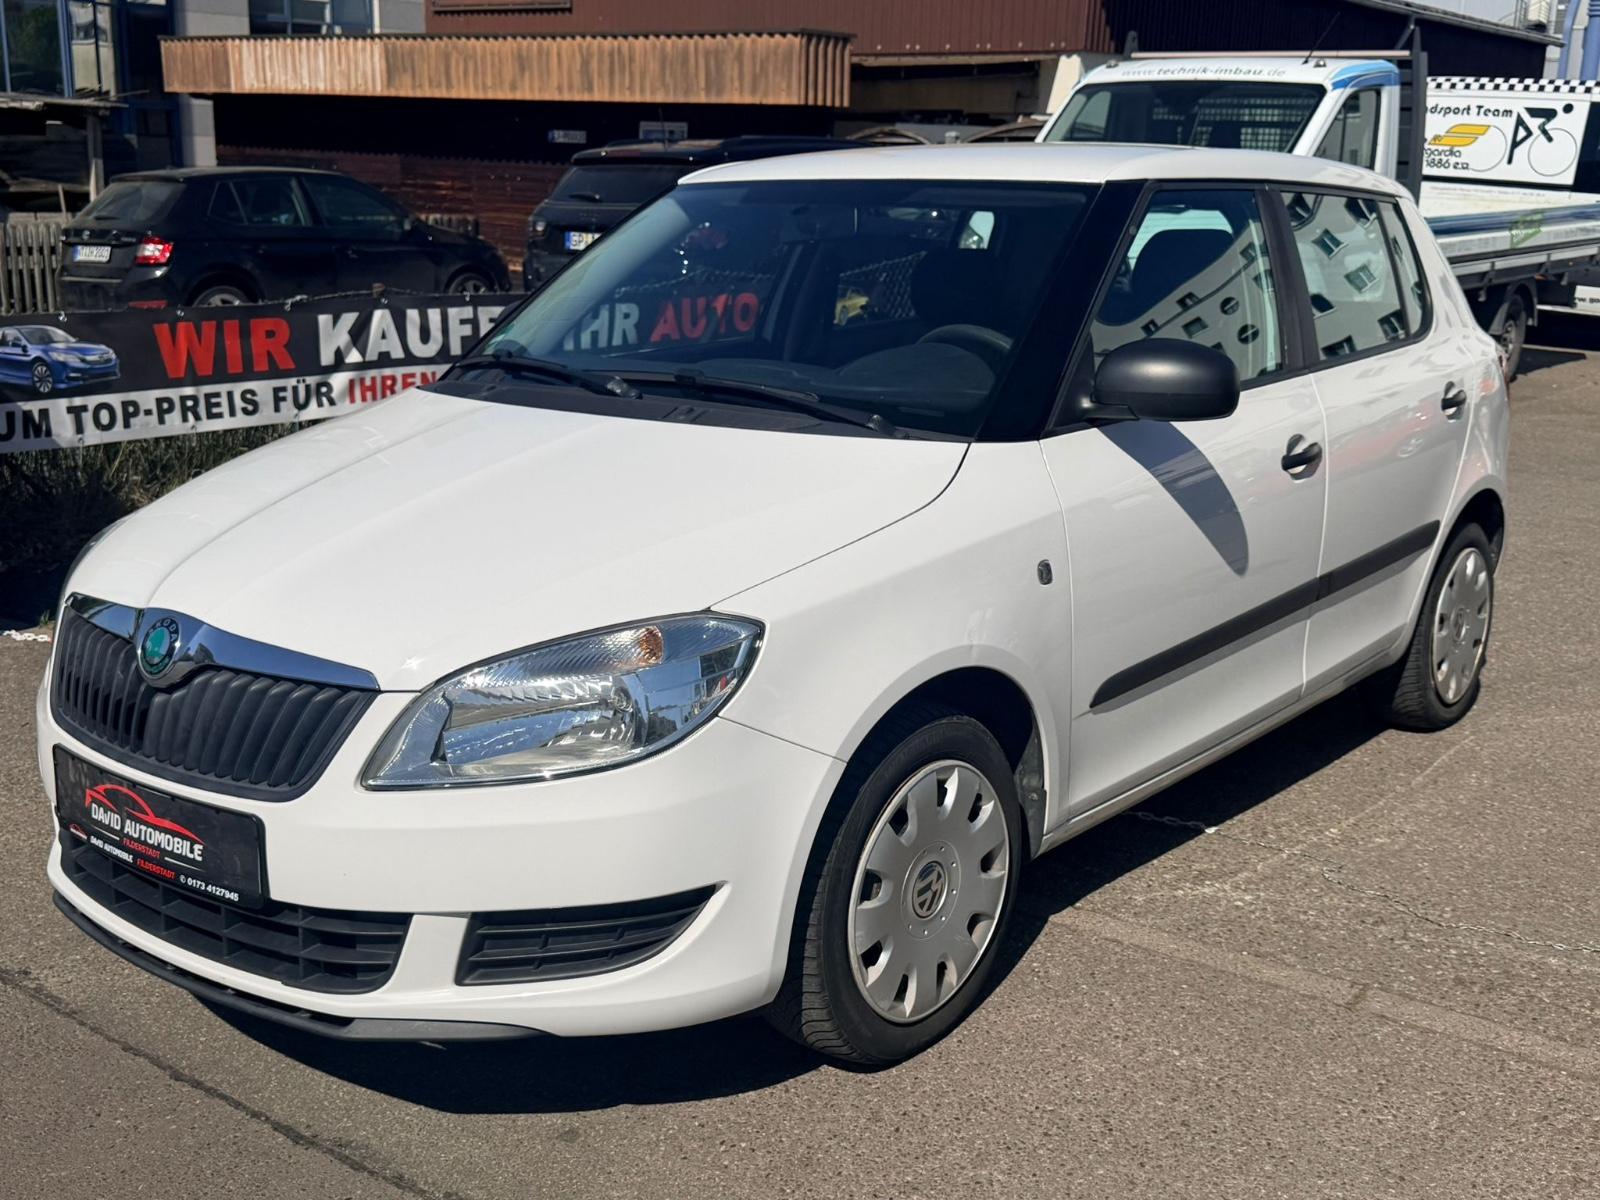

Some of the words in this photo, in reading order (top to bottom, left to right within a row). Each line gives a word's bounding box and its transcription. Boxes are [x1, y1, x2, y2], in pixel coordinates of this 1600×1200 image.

[1476, 105, 1513, 117] Team
[1426, 158, 1451, 169] 1886
[153, 317, 296, 379] WIR
[650, 293, 759, 342] AUTO
[66, 389, 260, 435] TOP-PREIS
[273, 379, 337, 413] FÜR
[91, 803, 121, 831] DAVID
[124, 819, 204, 861] AUTOMOBILE
[123, 837, 161, 859] FILDERSTADT
[90, 835, 104, 849] DAVID
[104, 843, 134, 863] AUTOMOBILE
[136, 858, 176, 879] FILDERSTADT
[187, 877, 205, 890] 0173
[206, 884, 239, 902] 4127945
